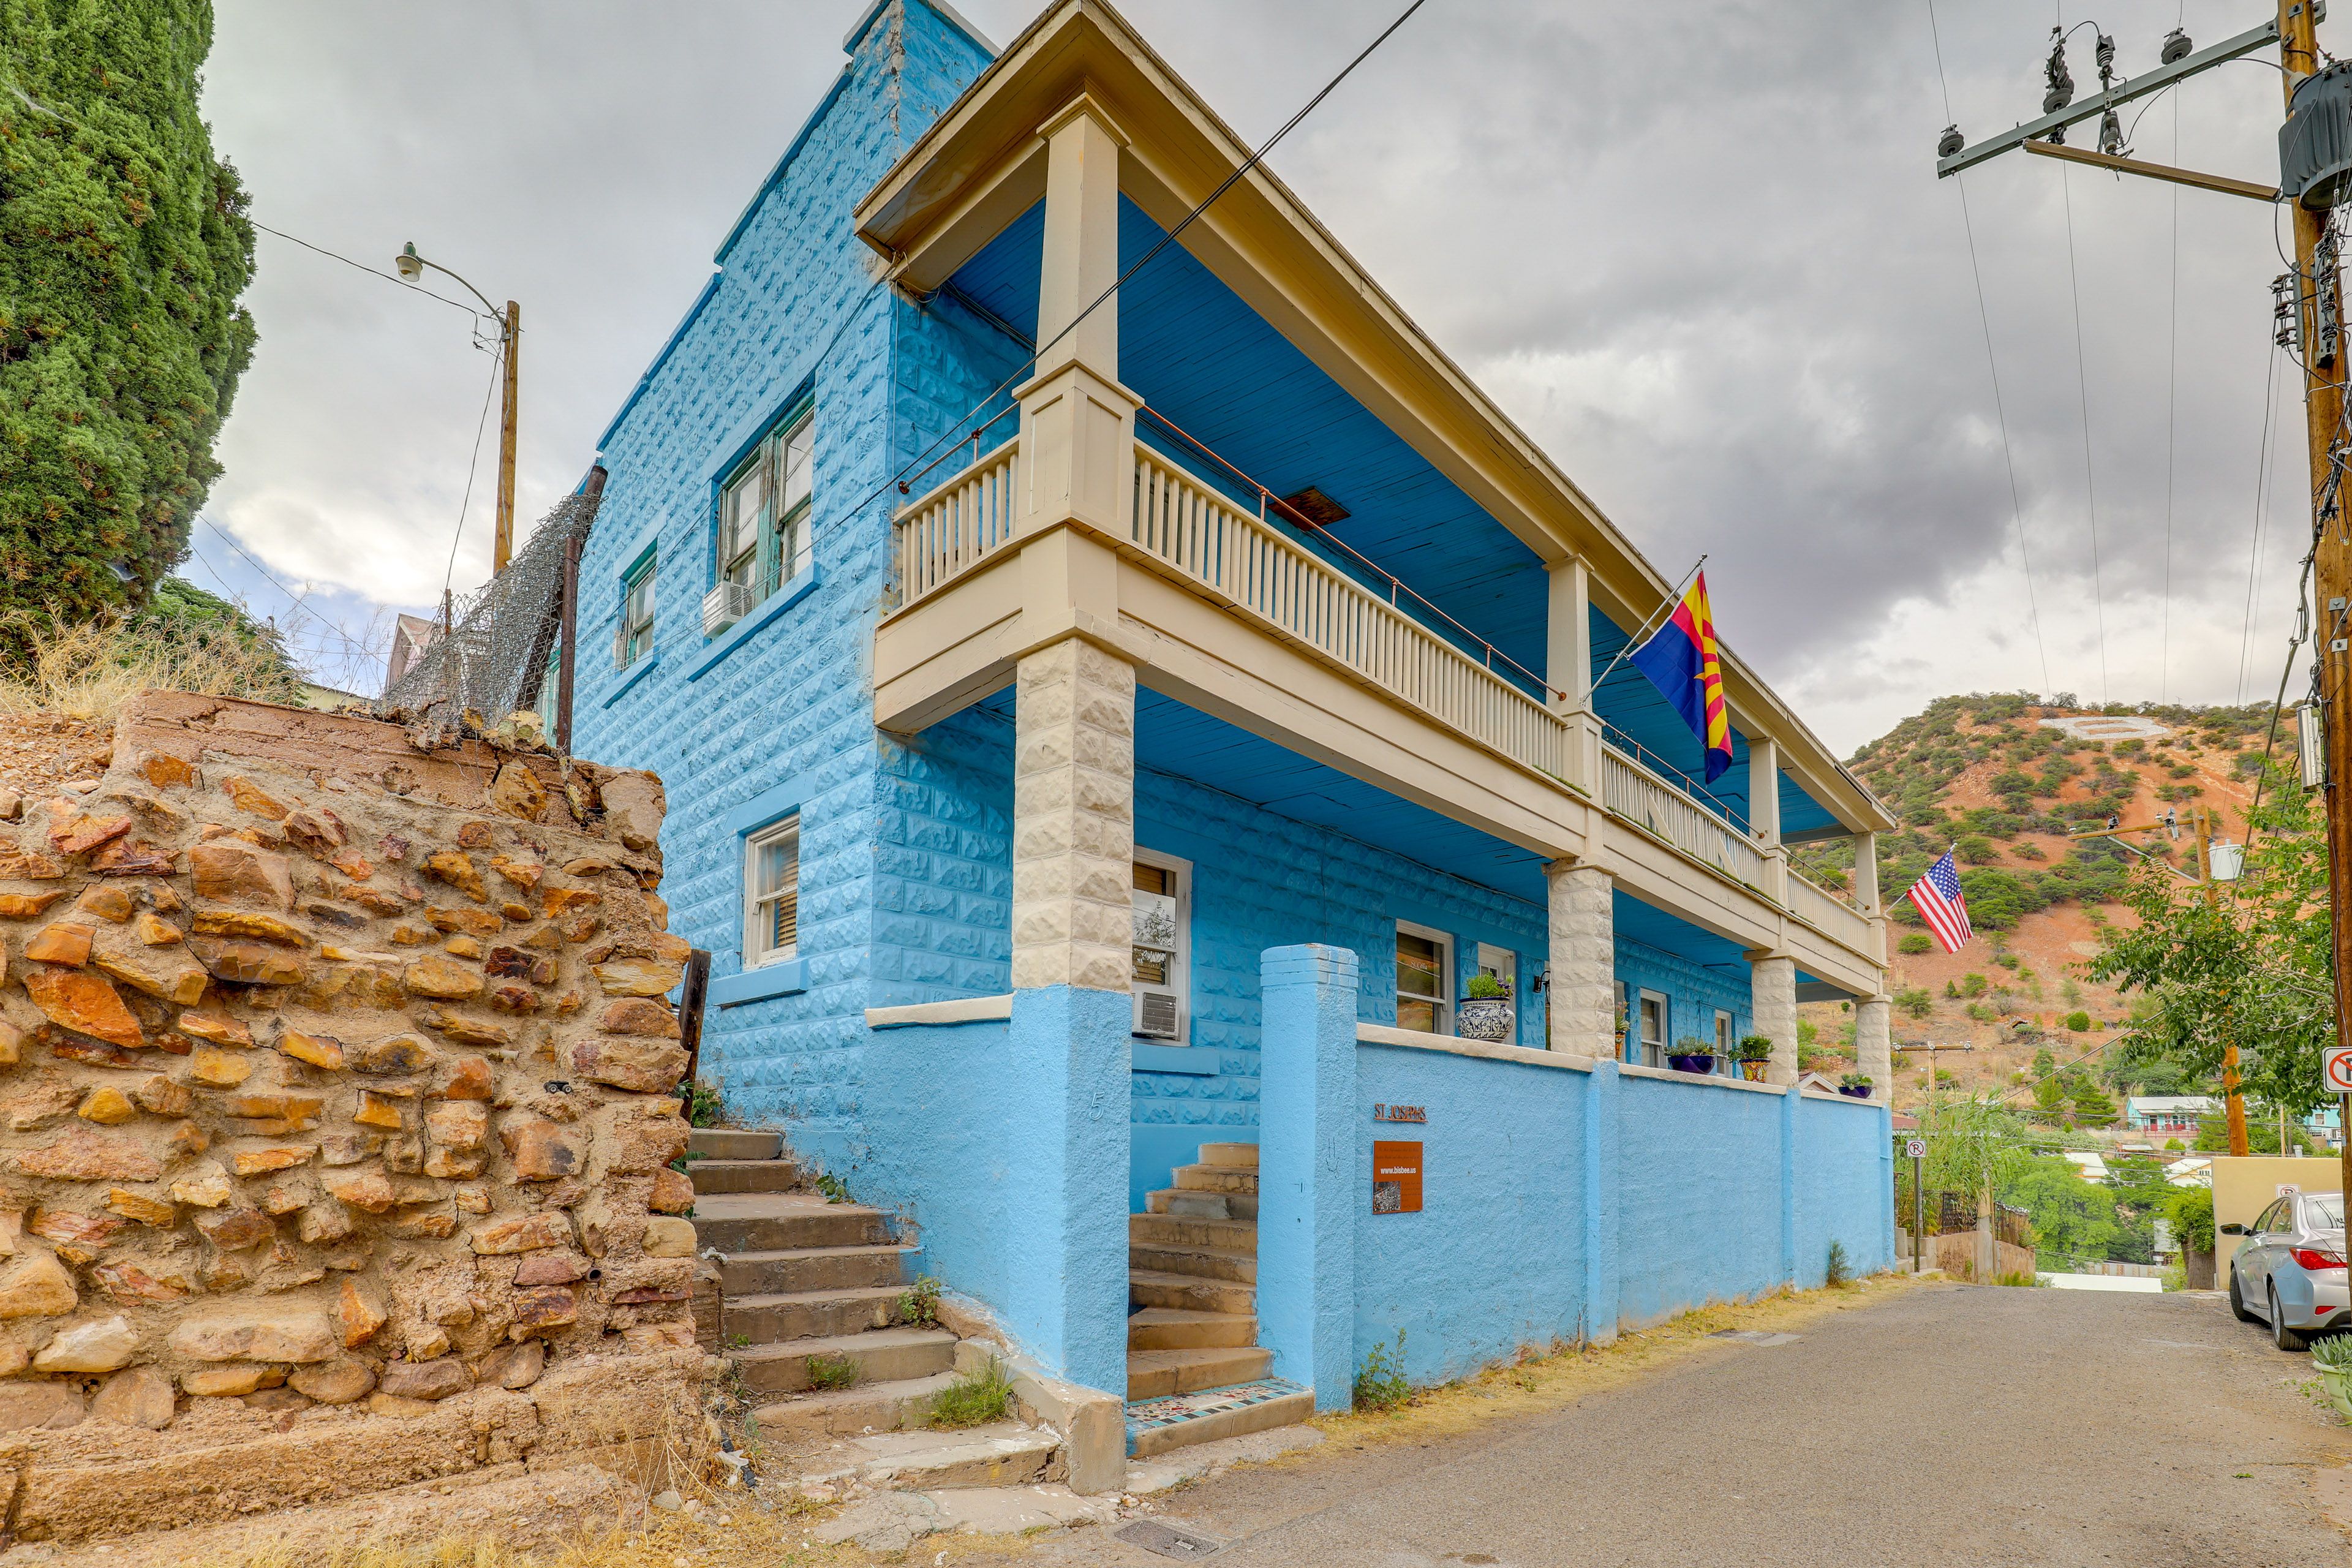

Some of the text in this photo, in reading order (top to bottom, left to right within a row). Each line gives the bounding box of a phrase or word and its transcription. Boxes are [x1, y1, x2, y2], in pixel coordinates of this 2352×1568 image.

[1089, 1091, 1105, 1120] 5
[1374, 1103, 1427, 1121] ST JOSEPHS
[1913, 1144, 1919, 1153] P
